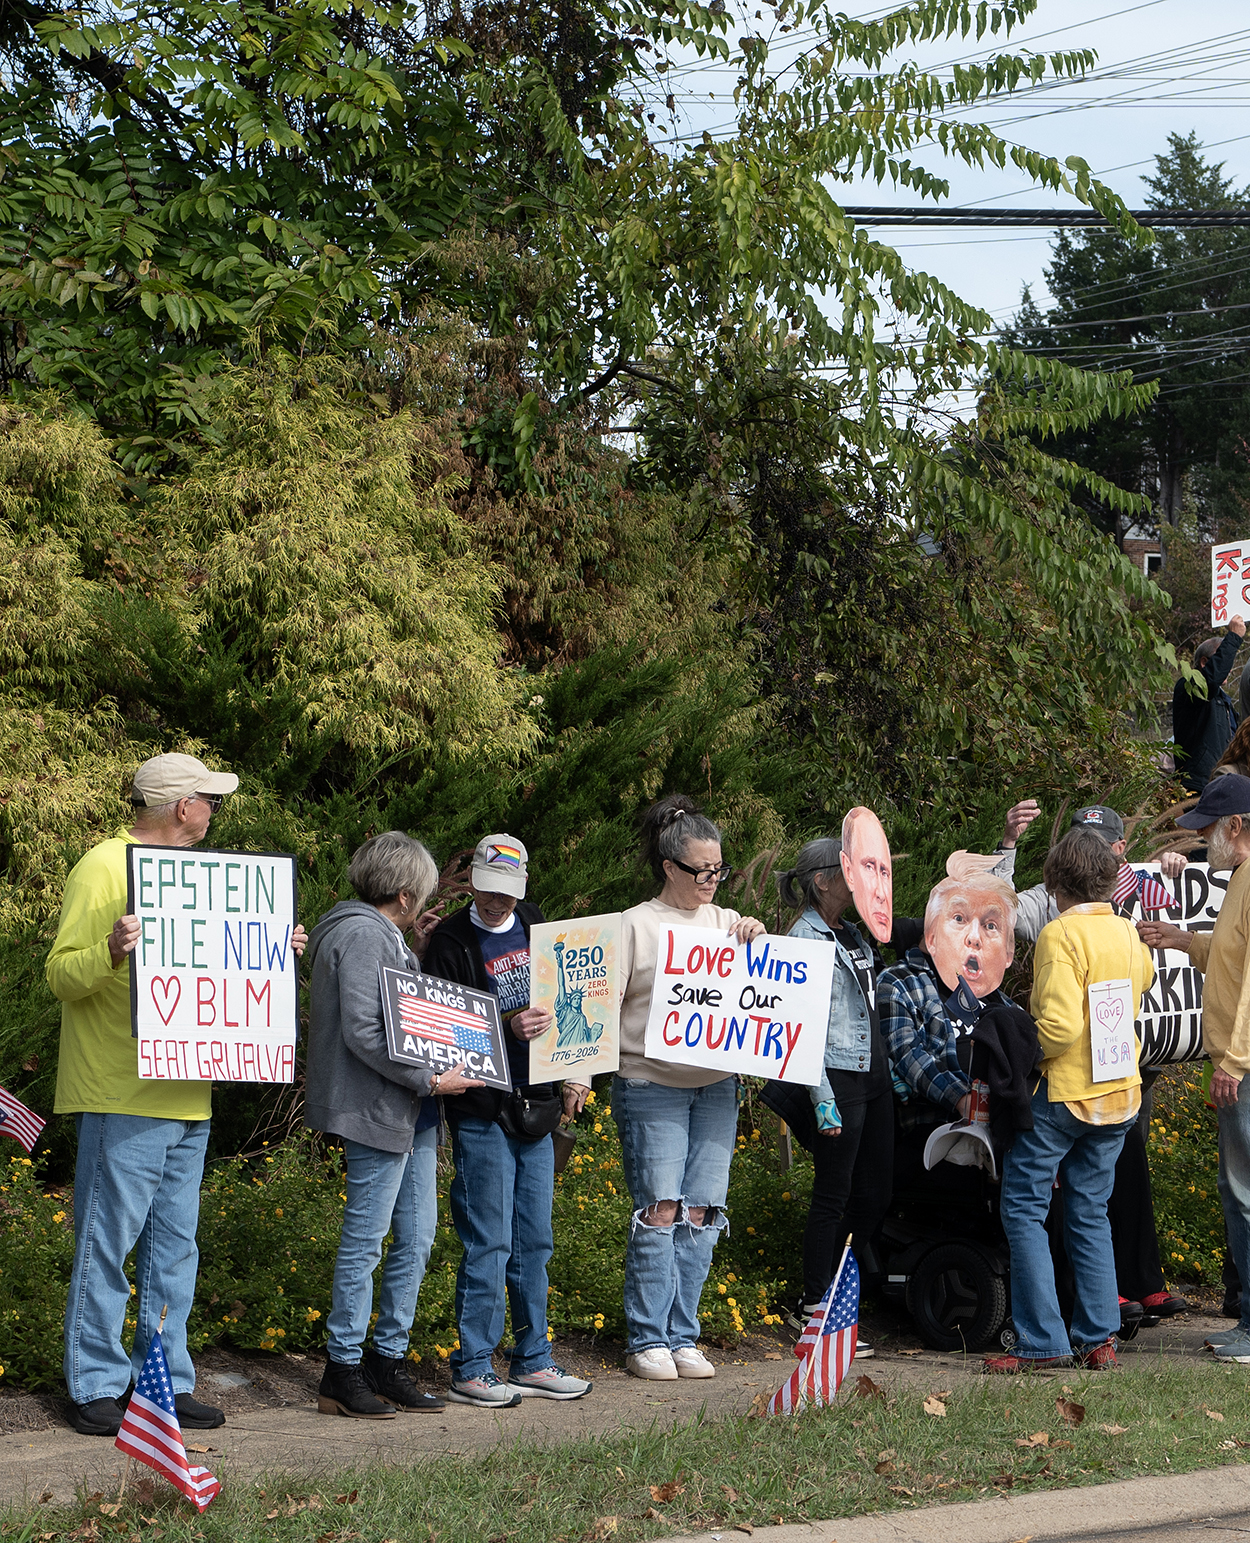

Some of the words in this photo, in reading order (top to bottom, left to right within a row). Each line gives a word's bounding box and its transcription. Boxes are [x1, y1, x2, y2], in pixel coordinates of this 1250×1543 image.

[1213, 549, 1242, 621] Kings
[139, 857, 275, 914] EPSTEIN
[141, 917, 208, 968] FILE
[224, 920, 289, 972] NOW
[565, 945, 604, 968] 250
[664, 930, 735, 978] Love
[746, 937, 808, 984] Wins
[567, 966, 607, 982] YEARS
[587, 979, 608, 990] ZERO
[197, 977, 270, 1027] BLM
[396, 978, 418, 995] NO
[425, 985, 467, 1010] KINGS
[473, 1000, 488, 1018] IN
[587, 988, 609, 998] KINGS
[739, 985, 782, 1010] Our
[1100, 1005, 1121, 1020] LOVE
[403, 1034, 498, 1076] AMERICA
[550, 1046, 599, 1063] 1776-2026
[663, 1010, 803, 1079] COUNTRY
[1098, 1042, 1131, 1066] USA
[1104, 1035, 1119, 1044] THE
[141, 1040, 189, 1079] SEAT
[196, 1041, 294, 1082] GRIJALVA
